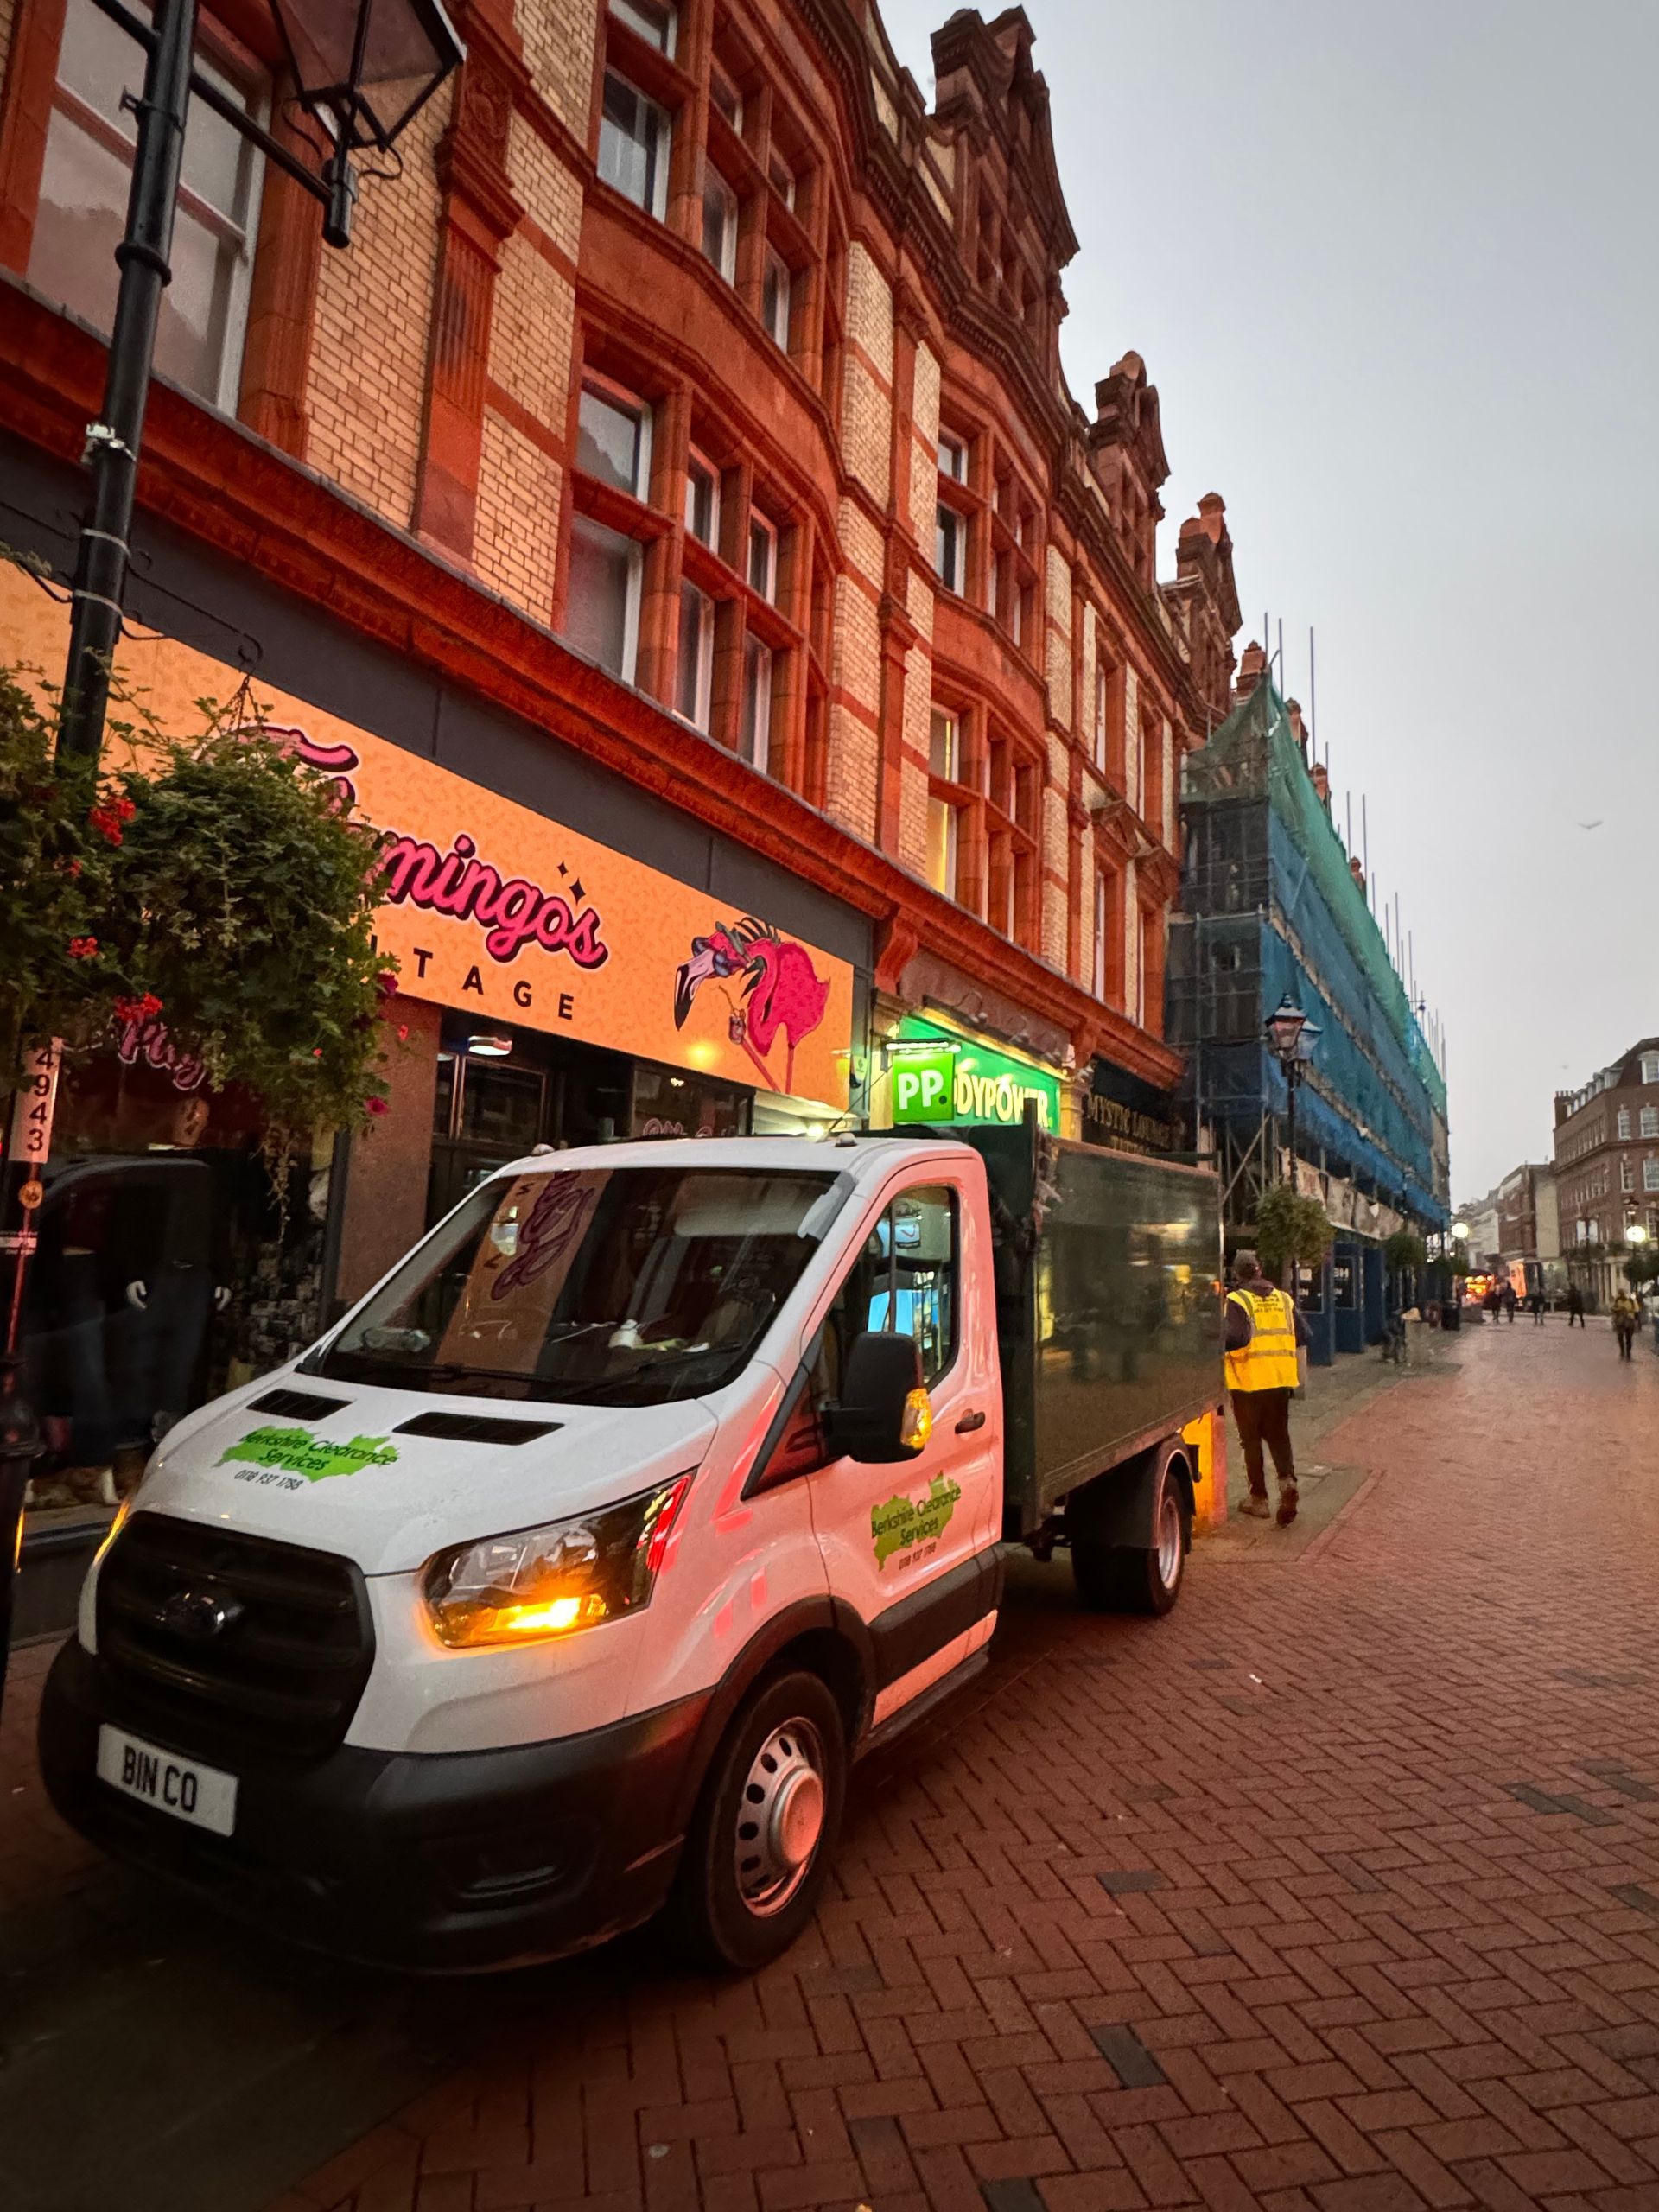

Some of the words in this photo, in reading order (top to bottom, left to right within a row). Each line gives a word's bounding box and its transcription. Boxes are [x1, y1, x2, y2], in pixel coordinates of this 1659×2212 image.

[1087, 1092, 1131, 1135] MYSTIC
[239, 1430, 308, 1450] Berkshire
[308, 1440, 398, 1466] Clearance
[259, 1447, 330, 1471] Services
[871, 1505, 915, 1540] Berkshire
[917, 1486, 962, 1517] Clearance
[900, 1517, 938, 1546] Services
[121, 1744, 159, 1798] BIN
[163, 1764, 198, 1813] CO
